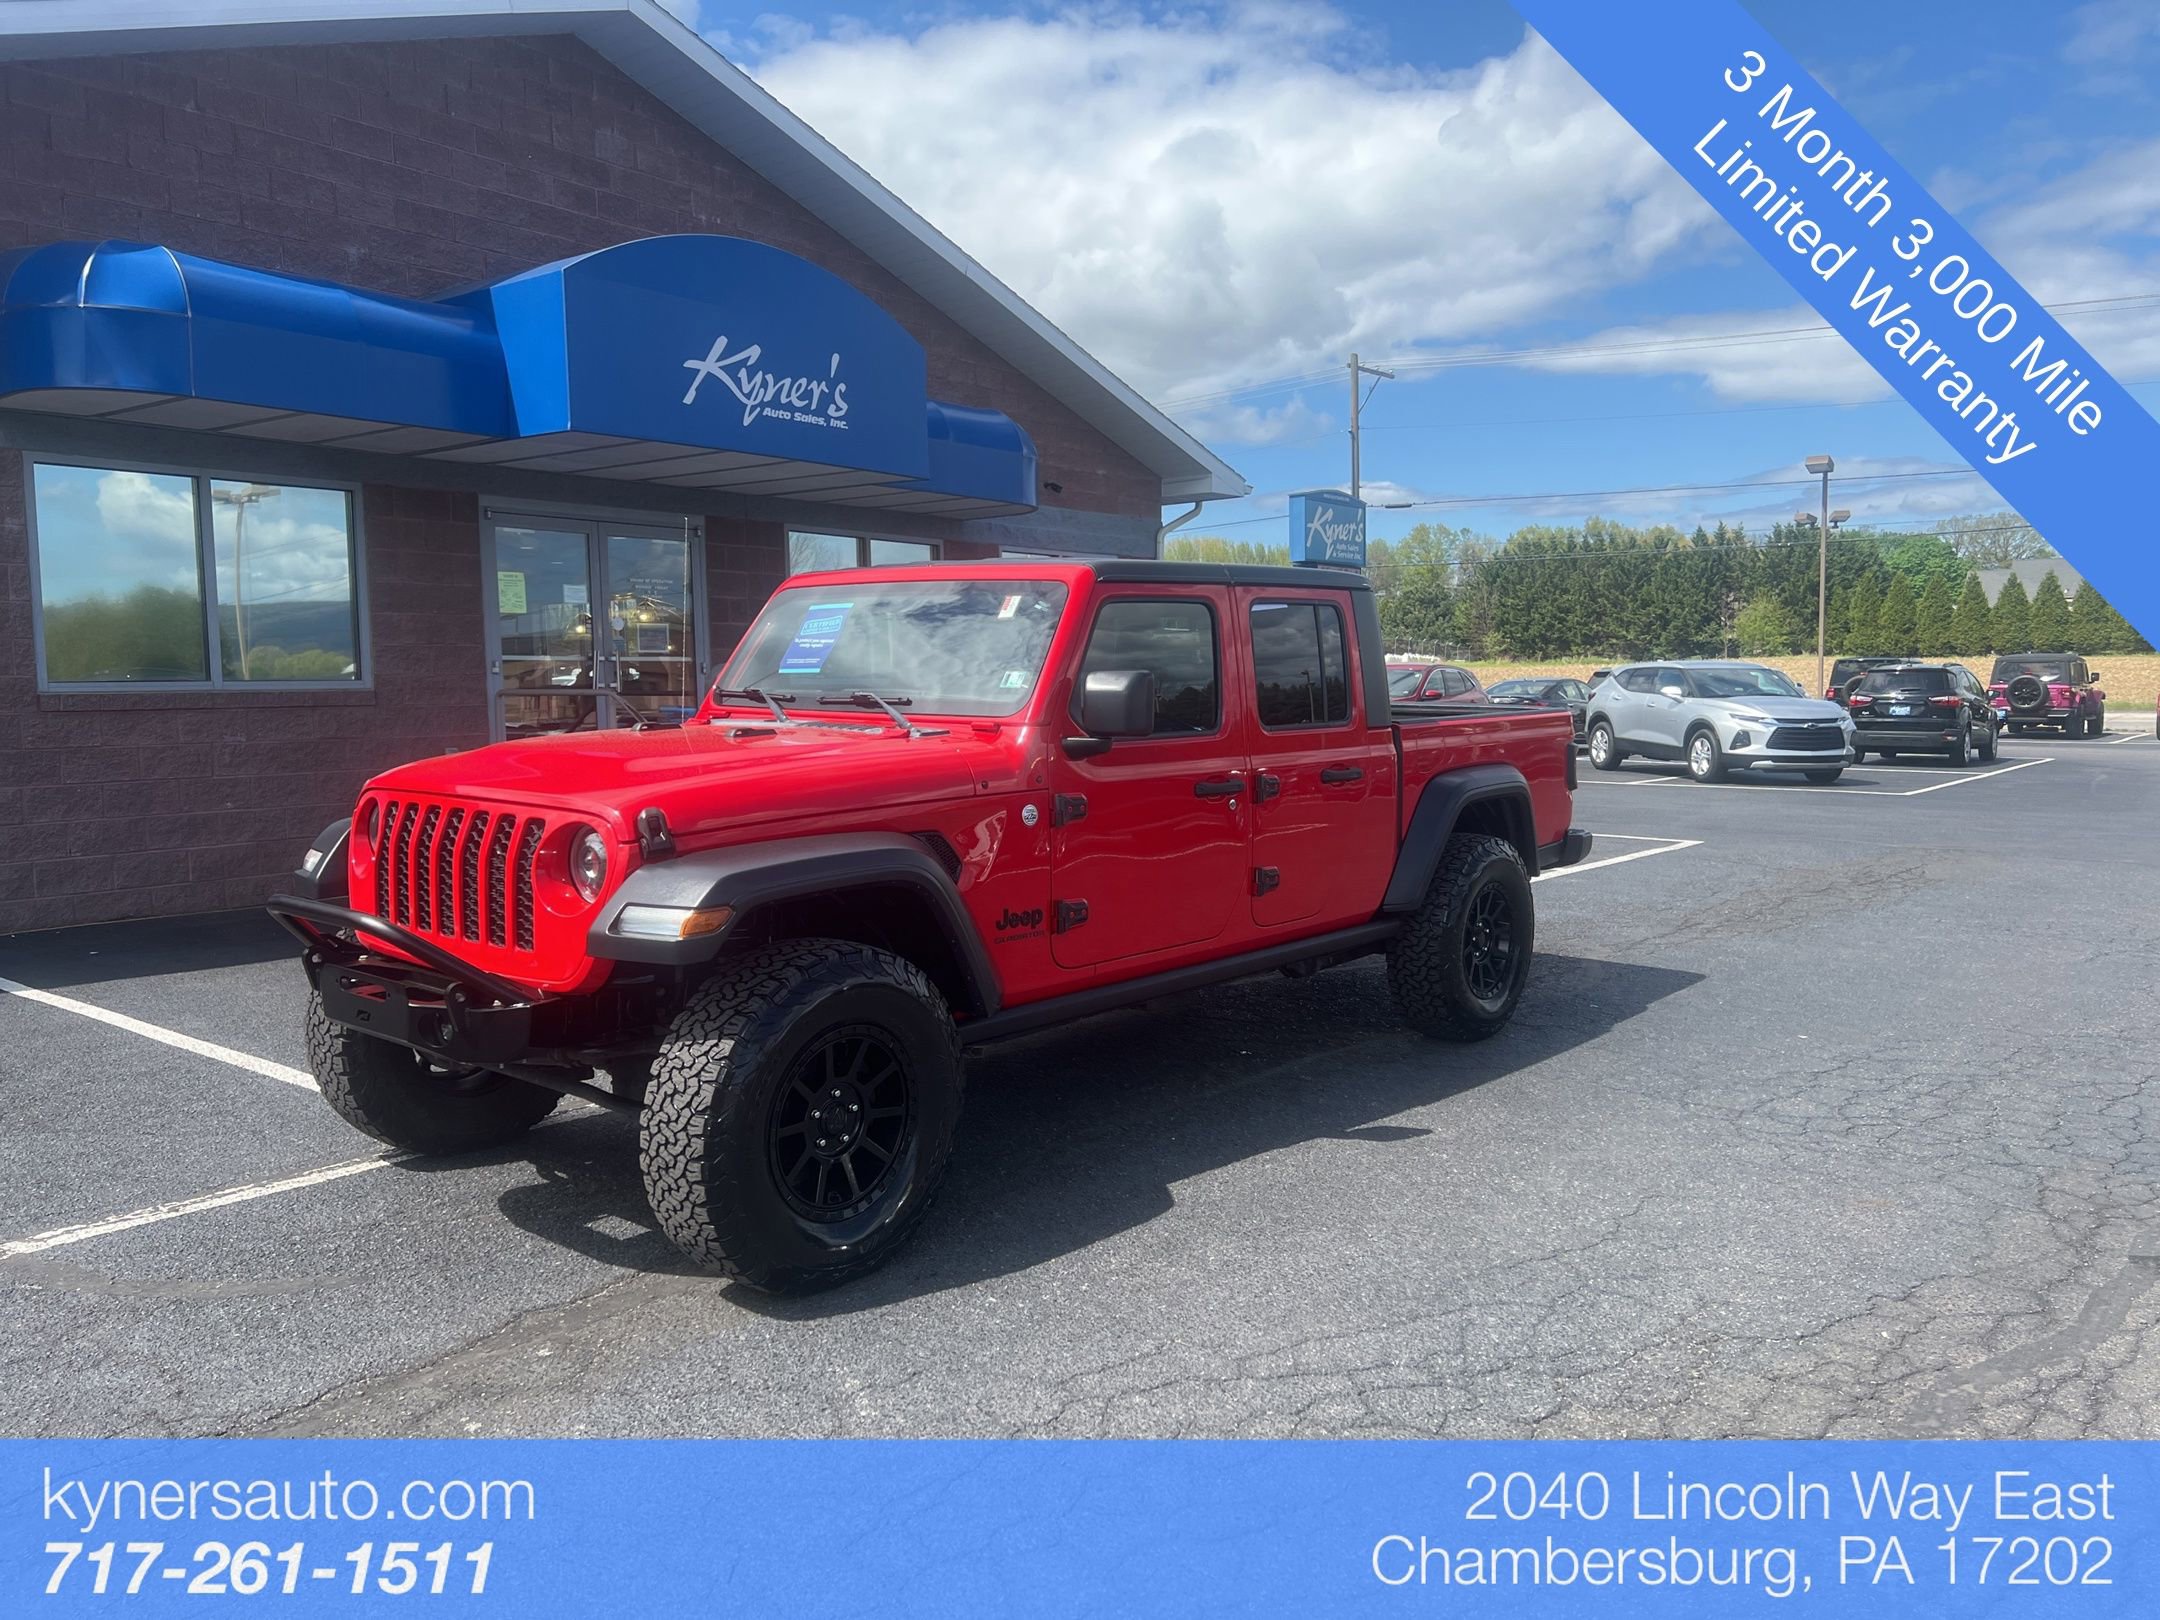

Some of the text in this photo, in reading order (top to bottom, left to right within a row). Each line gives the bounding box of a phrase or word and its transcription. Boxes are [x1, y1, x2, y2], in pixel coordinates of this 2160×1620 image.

[683, 336, 848, 426] Kyner's
[763, 407, 848, 429] Auto Sales, Inc.
[1306, 505, 1364, 560] Kyner's
[996, 908, 1043, 930] Jeep
